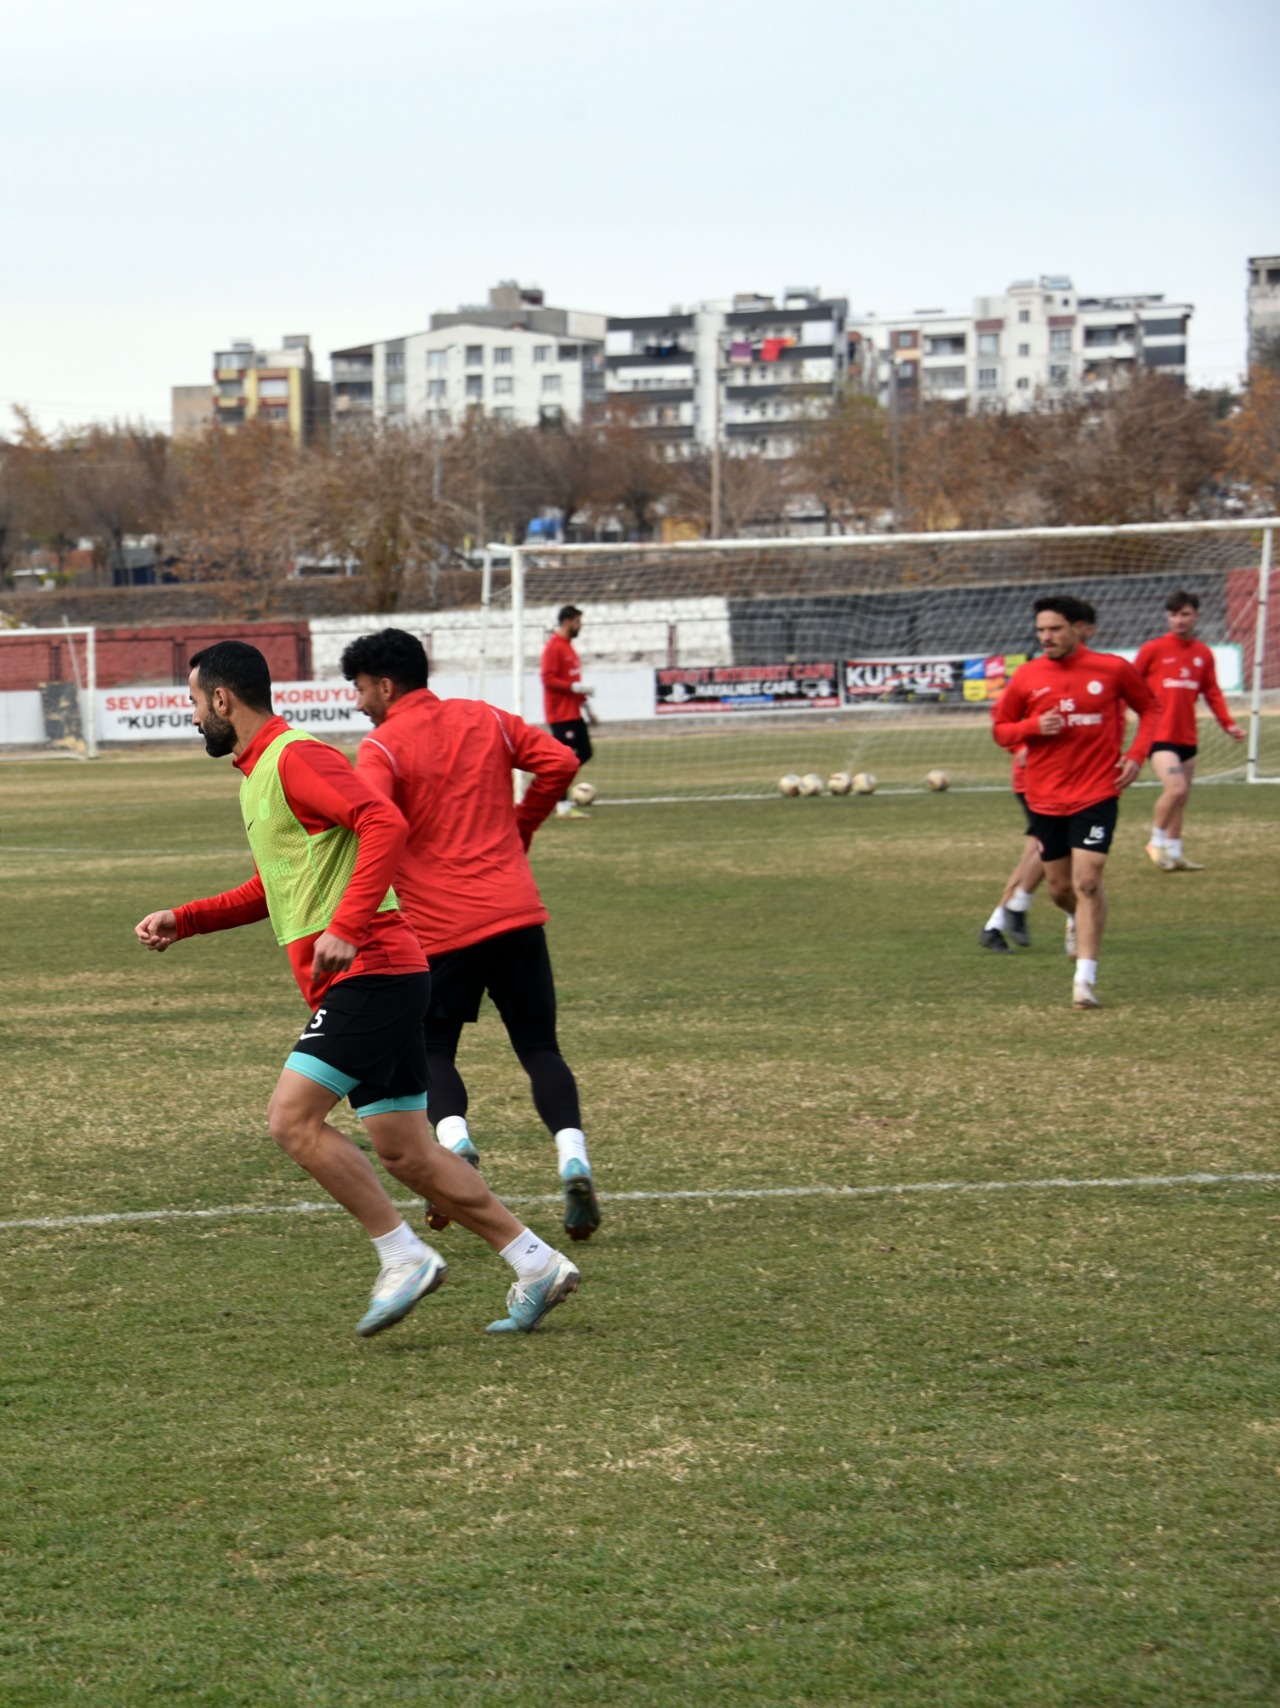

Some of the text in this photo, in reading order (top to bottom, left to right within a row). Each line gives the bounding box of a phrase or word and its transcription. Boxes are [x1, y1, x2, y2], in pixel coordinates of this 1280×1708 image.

[762, 680, 797, 694] CAFE
[105, 687, 357, 711] SEVDİKL KORUYU
[118, 712, 193, 729] "KÜFÜR
[1089, 826, 1105, 839] 16
[310, 1009, 327, 1029] 5
